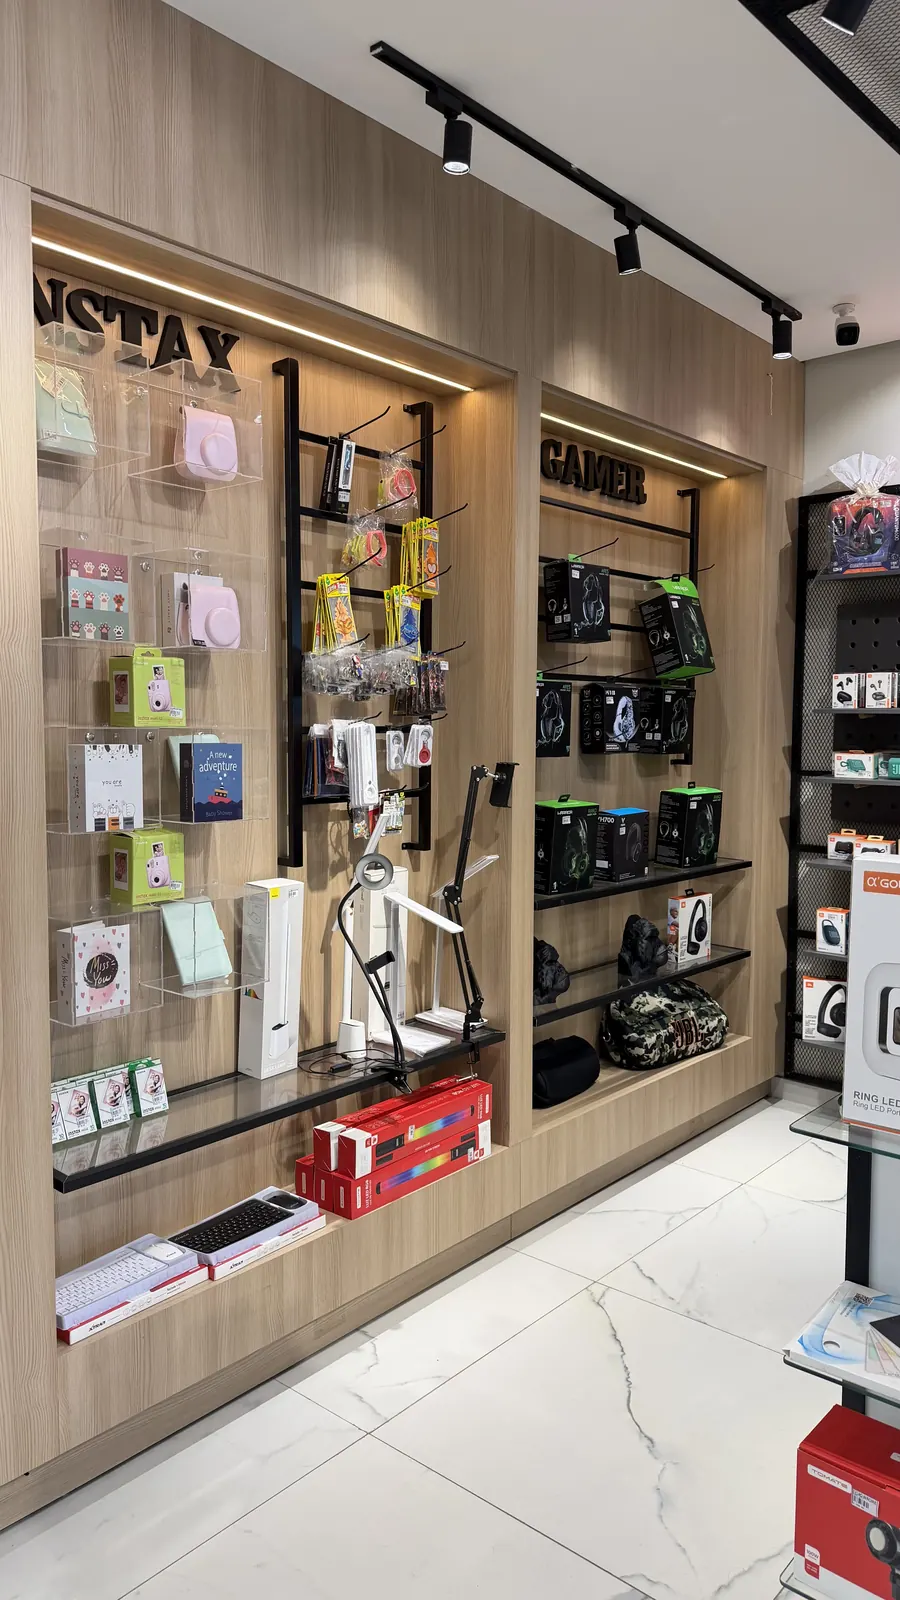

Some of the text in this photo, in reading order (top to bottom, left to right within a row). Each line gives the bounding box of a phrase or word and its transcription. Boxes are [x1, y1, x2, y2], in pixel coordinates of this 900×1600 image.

[540, 439, 647, 504] GAMER
[199, 760, 237, 773] adventure
[90, 956, 109, 973] Miss
[93, 971, 112, 987] You
[670, 1016, 704, 1048] JBL
[853, 1090, 900, 1108] RING LED
[853, 1100, 869, 1110] Ring
[870, 1104, 885, 1113] LED
